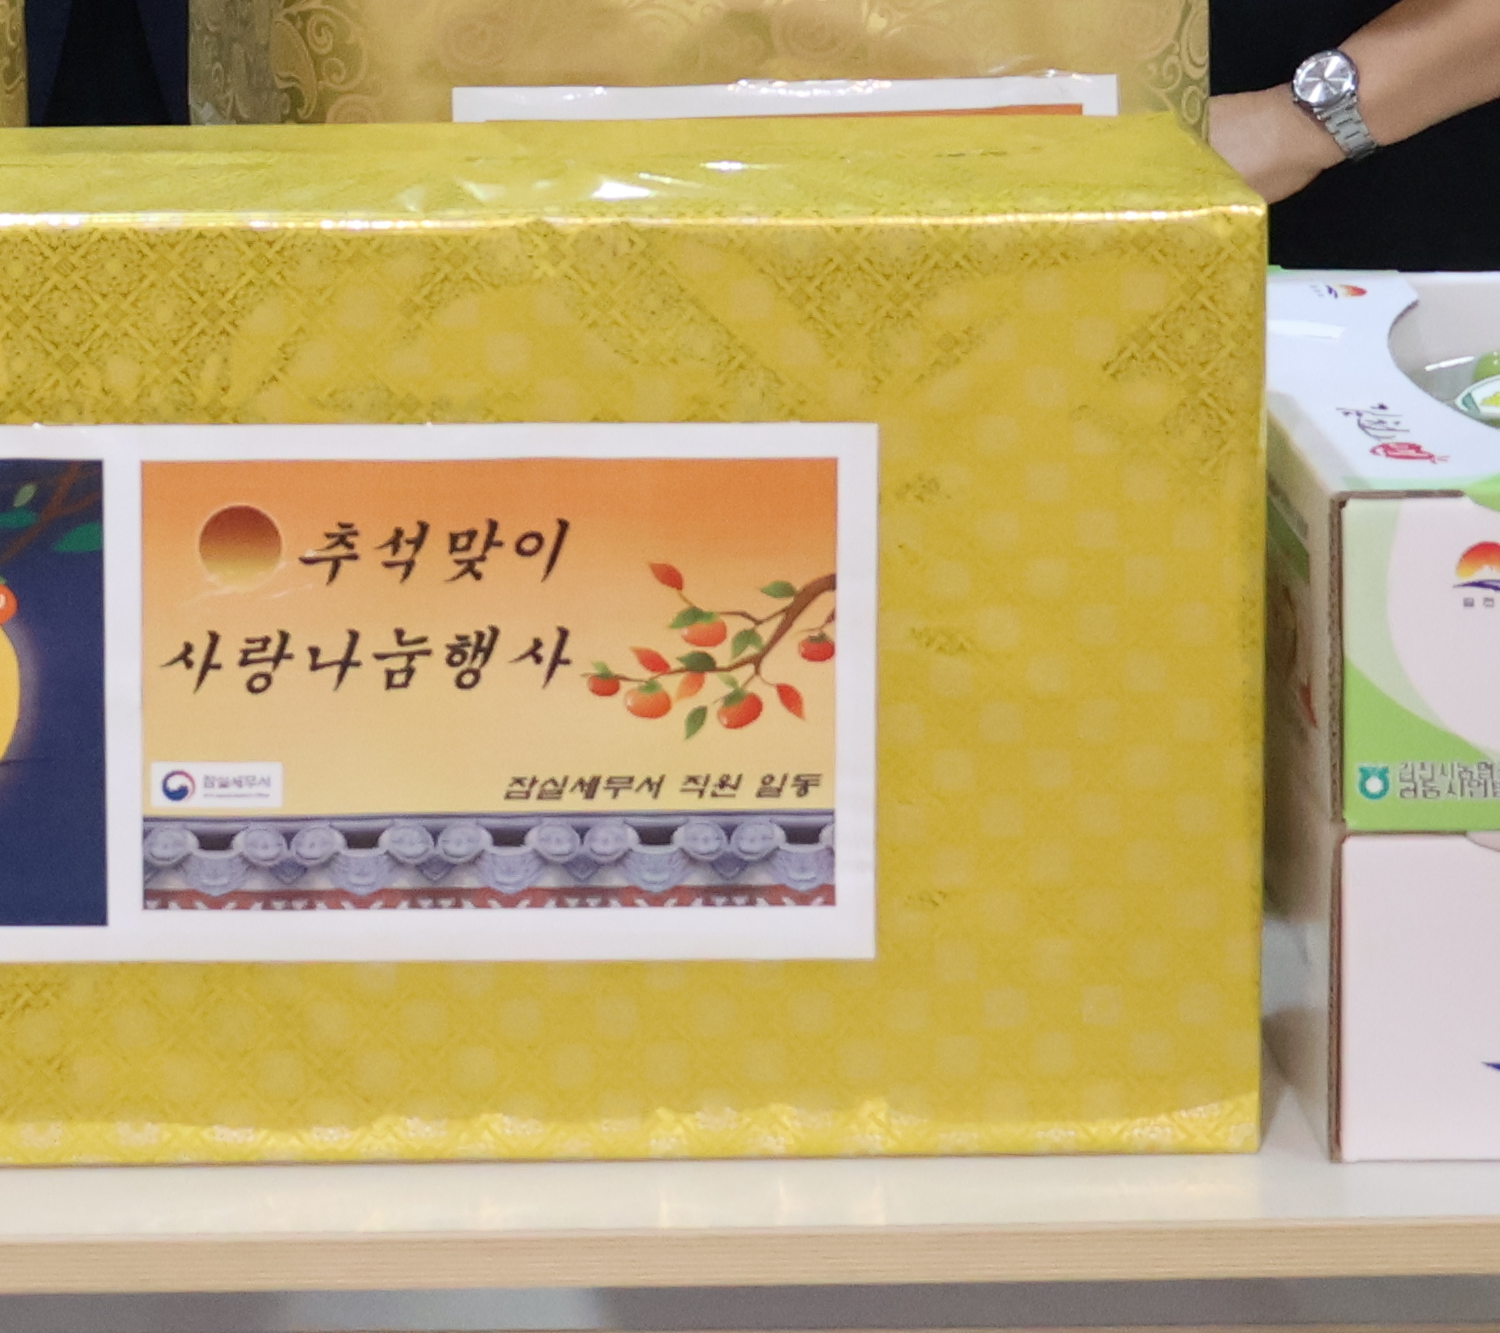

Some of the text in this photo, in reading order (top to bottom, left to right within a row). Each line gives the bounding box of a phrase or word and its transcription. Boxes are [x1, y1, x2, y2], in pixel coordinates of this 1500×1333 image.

[299, 516, 571, 586] 추석맞이
[160, 625, 573, 695] 사랑나눔행사
[503, 773, 822, 801] 잠실세무서 직원 일동
